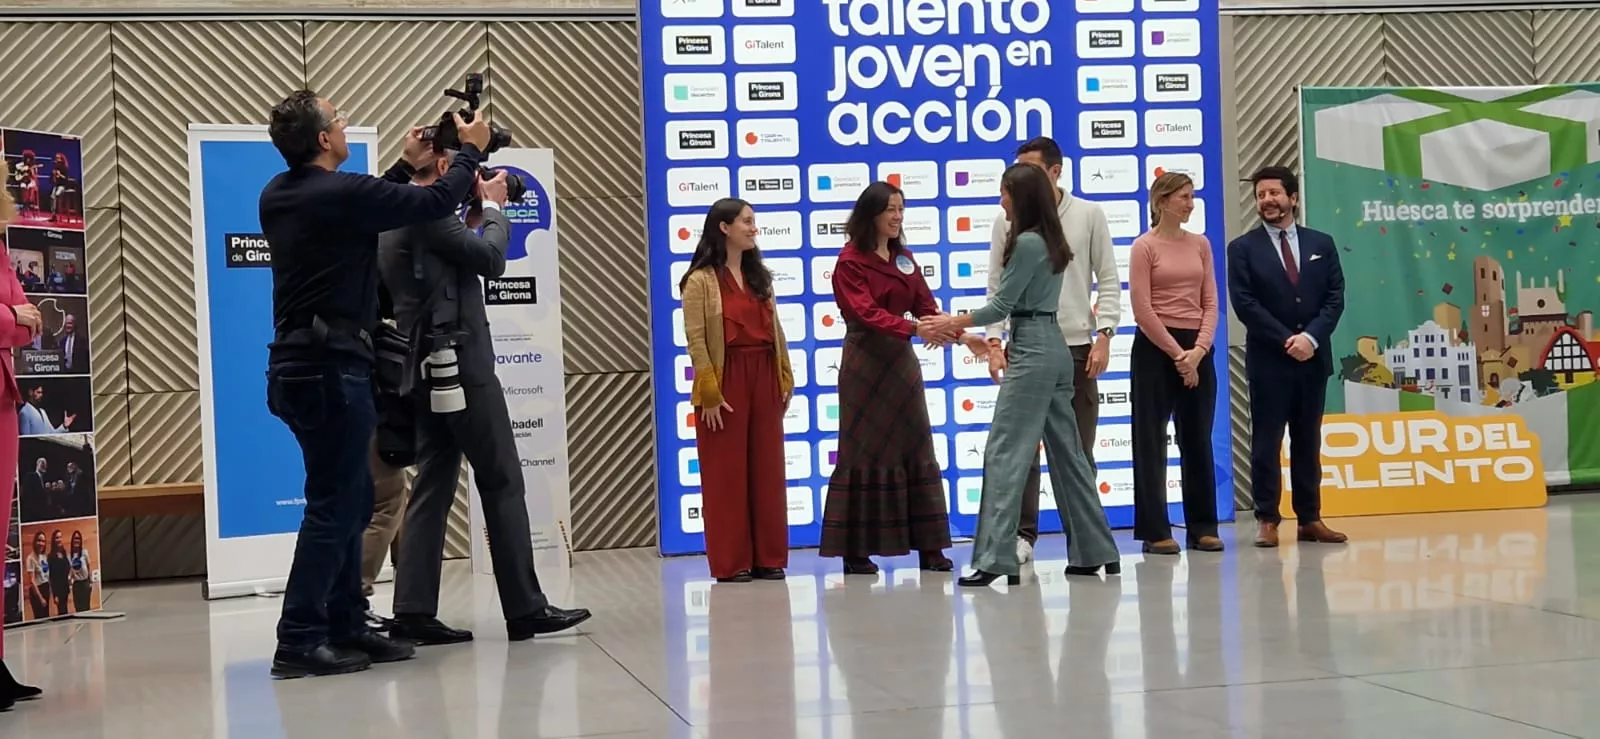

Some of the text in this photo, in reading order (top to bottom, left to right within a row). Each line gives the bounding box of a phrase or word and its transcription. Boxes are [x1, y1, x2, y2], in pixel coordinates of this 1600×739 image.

[823, 0, 1050, 36] talento
[678, 37, 709, 45] Princesa
[745, 40, 784, 49] GiTalent
[1098, 38, 1120, 46] Girona
[686, 44, 709, 52] Girona
[827, 40, 1052, 102] joven en
[751, 83, 781, 91] Princesa
[828, 85, 1053, 146] acción
[1155, 124, 1192, 133] GiTalent
[681, 132, 712, 140] Princesa
[689, 139, 712, 147] Girona
[679, 182, 718, 191] GiTalent
[1362, 200, 1448, 221] Huesca
[1453, 201, 1475, 220] te
[759, 226, 791, 236] iTalent
[231, 237, 270, 248] Prince
[232, 250, 271, 262] de Giro
[488, 281, 530, 289] Princesa
[499, 291, 532, 300] Girona
[26, 353, 59, 361] Princesa
[496, 351, 542, 364] avante
[34, 363, 60, 371] Girona
[502, 385, 543, 395] Microsoft
[511, 418, 544, 429] badell
[1100, 438, 1131, 447] GiTale
[1282, 419, 1532, 459] OUR DEL
[520, 456, 556, 467] Channel
